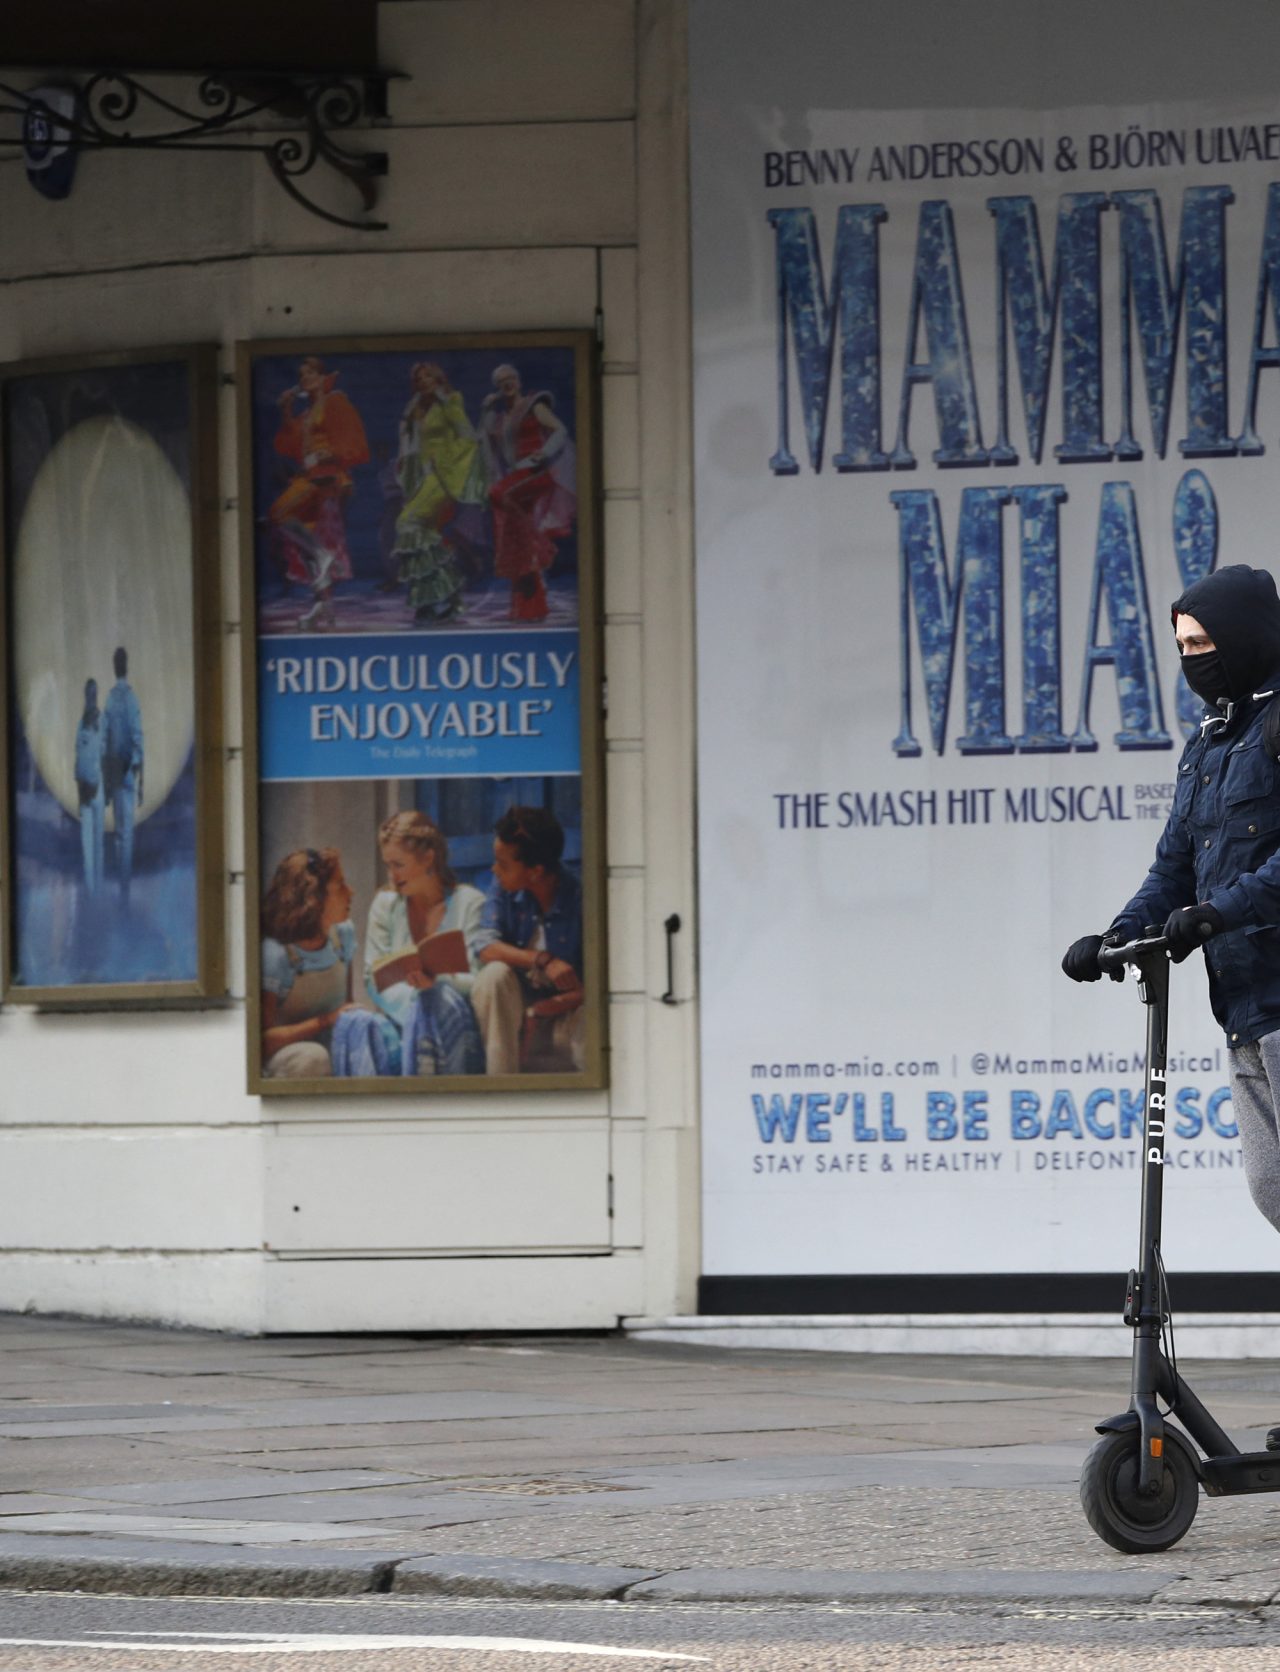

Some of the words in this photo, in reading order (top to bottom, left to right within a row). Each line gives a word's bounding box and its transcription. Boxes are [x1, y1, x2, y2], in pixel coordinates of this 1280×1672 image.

[764, 147, 860, 188] BENNY
[866, 136, 1045, 184] ANDERSSON
[1053, 135, 1078, 172] &
[1088, 125, 1187, 171] BJÖRN
[774, 793, 829, 830] THE
[836, 790, 937, 828] SMASH
[947, 788, 996, 825] HIT
[1003, 784, 1131, 823] MUSICAL
[1134, 783, 1177, 799] BASED
[1134, 803, 1161, 820] THE
[751, 1057, 939, 1080] mamma-mia.com
[970, 1048, 1221, 1076] @MammaMiaMsical
[751, 1090, 907, 1143] WE'LL
[926, 1090, 989, 1142] BE
[1010, 1087, 1146, 1141] BACK
[1148, 1068, 1167, 1165] PURE
[753, 1153, 802, 1174] STAY
[815, 1152, 869, 1174] SAFE
[880, 1153, 895, 1173] &
[905, 1151, 1002, 1173] HEALTHY
[1035, 1150, 1136, 1171] DELFONT
